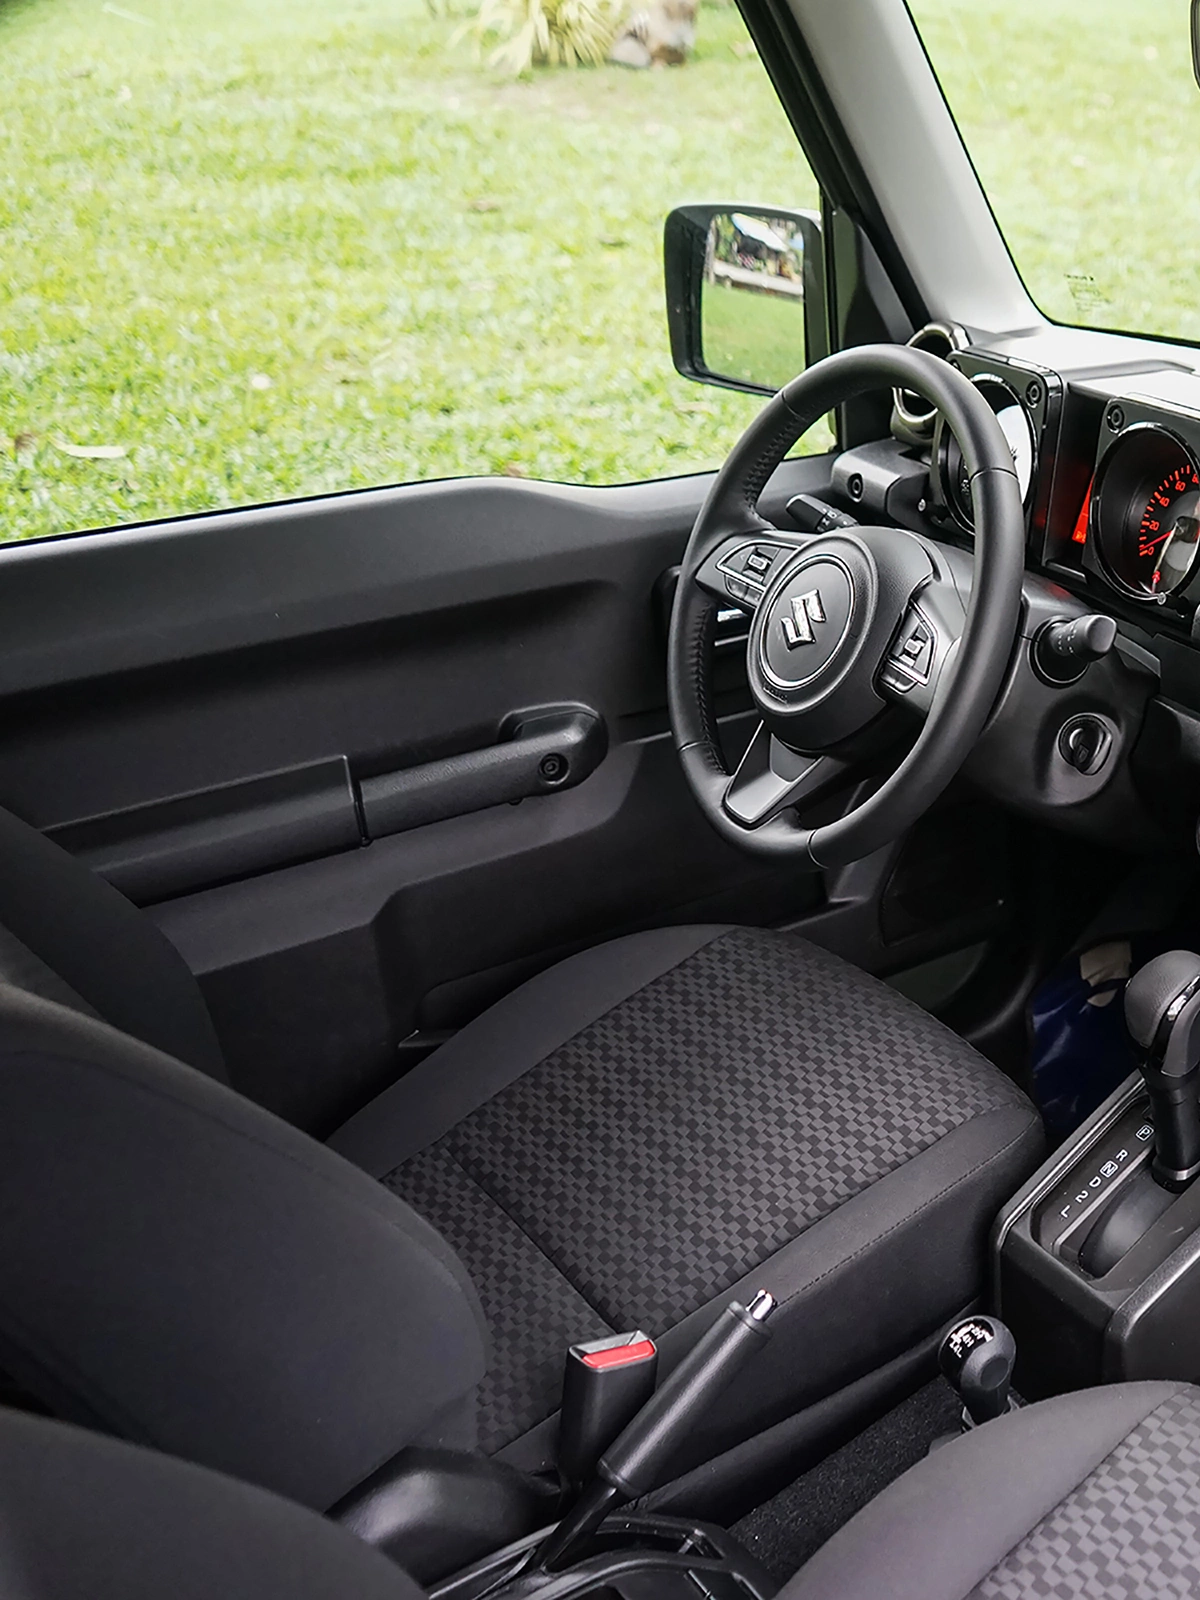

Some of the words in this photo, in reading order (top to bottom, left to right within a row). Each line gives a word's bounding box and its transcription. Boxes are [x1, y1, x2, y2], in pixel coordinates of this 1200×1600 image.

[1138, 1126, 1151, 1138] P
[1116, 1149, 1129, 1162] R
[1089, 1176, 1102, 1188] D
[1075, 1190, 1090, 1203] 2
[1060, 1205, 1071, 1219] L
